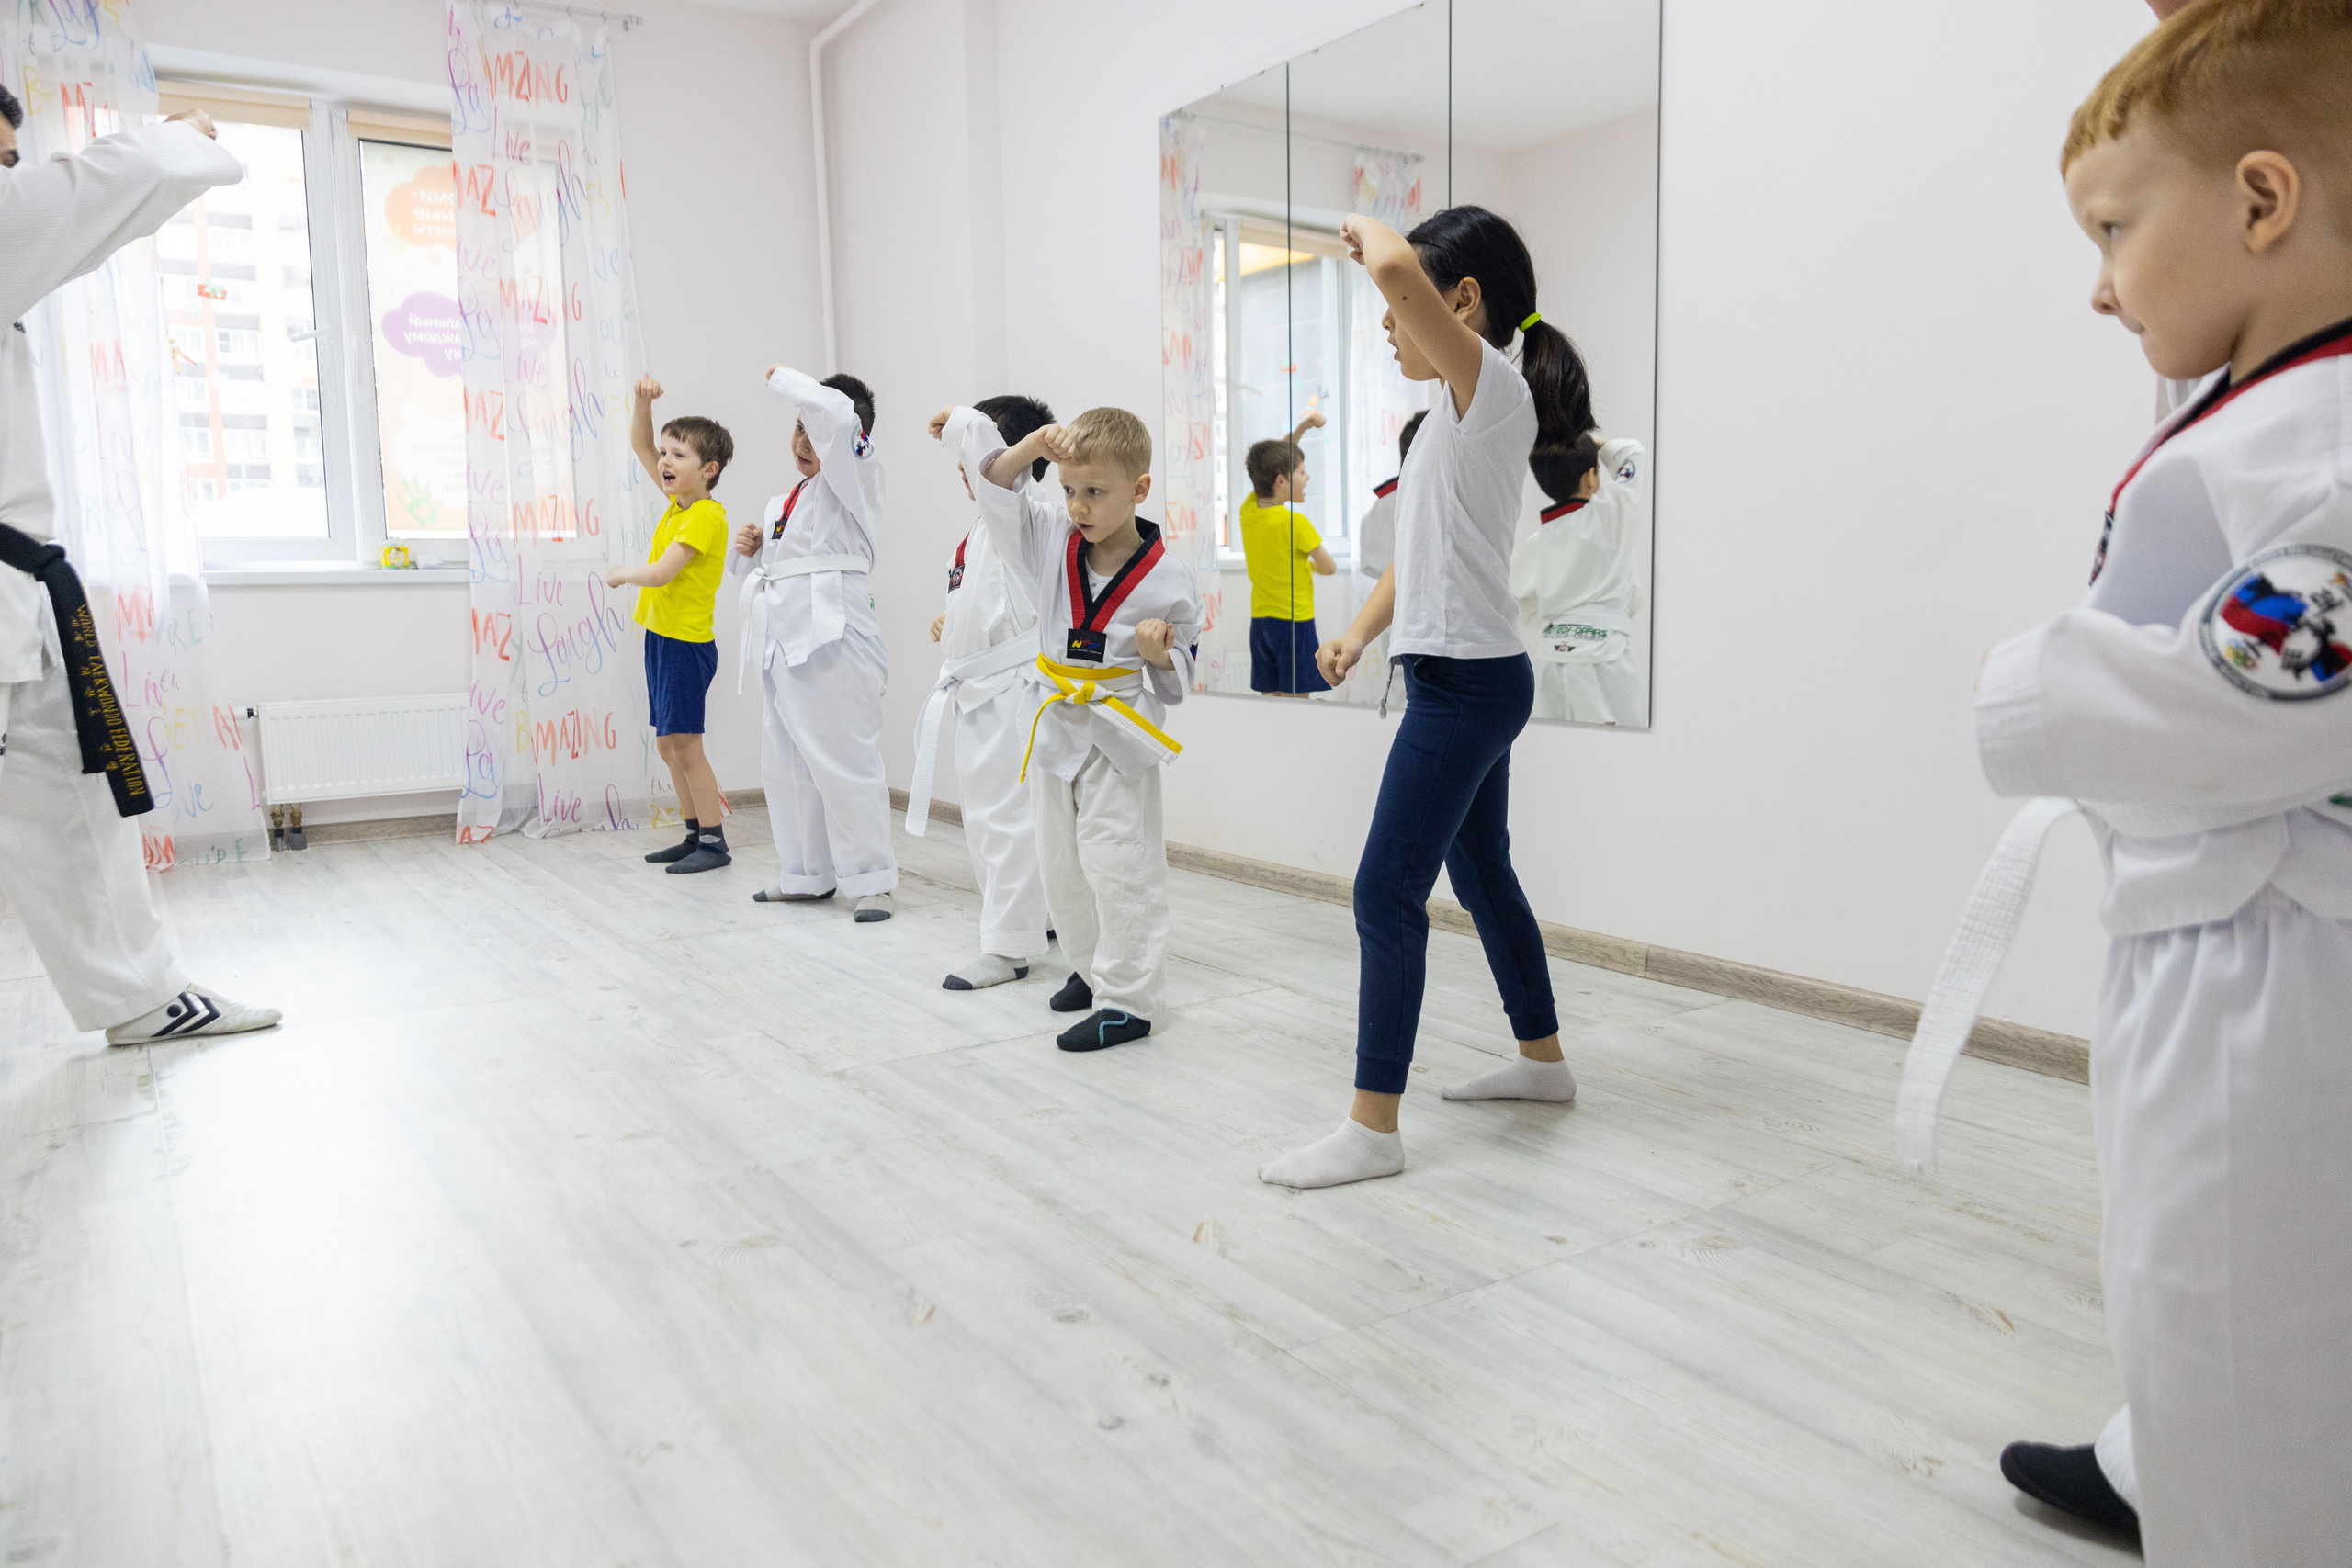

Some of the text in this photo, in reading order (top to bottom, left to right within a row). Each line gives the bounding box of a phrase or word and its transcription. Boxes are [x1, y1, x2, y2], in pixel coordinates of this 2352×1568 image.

[517, 553, 563, 607] Live
[527, 570, 625, 697] Laugh
[112, 727, 146, 797] FEDERATION
[537, 772, 582, 824] Live
